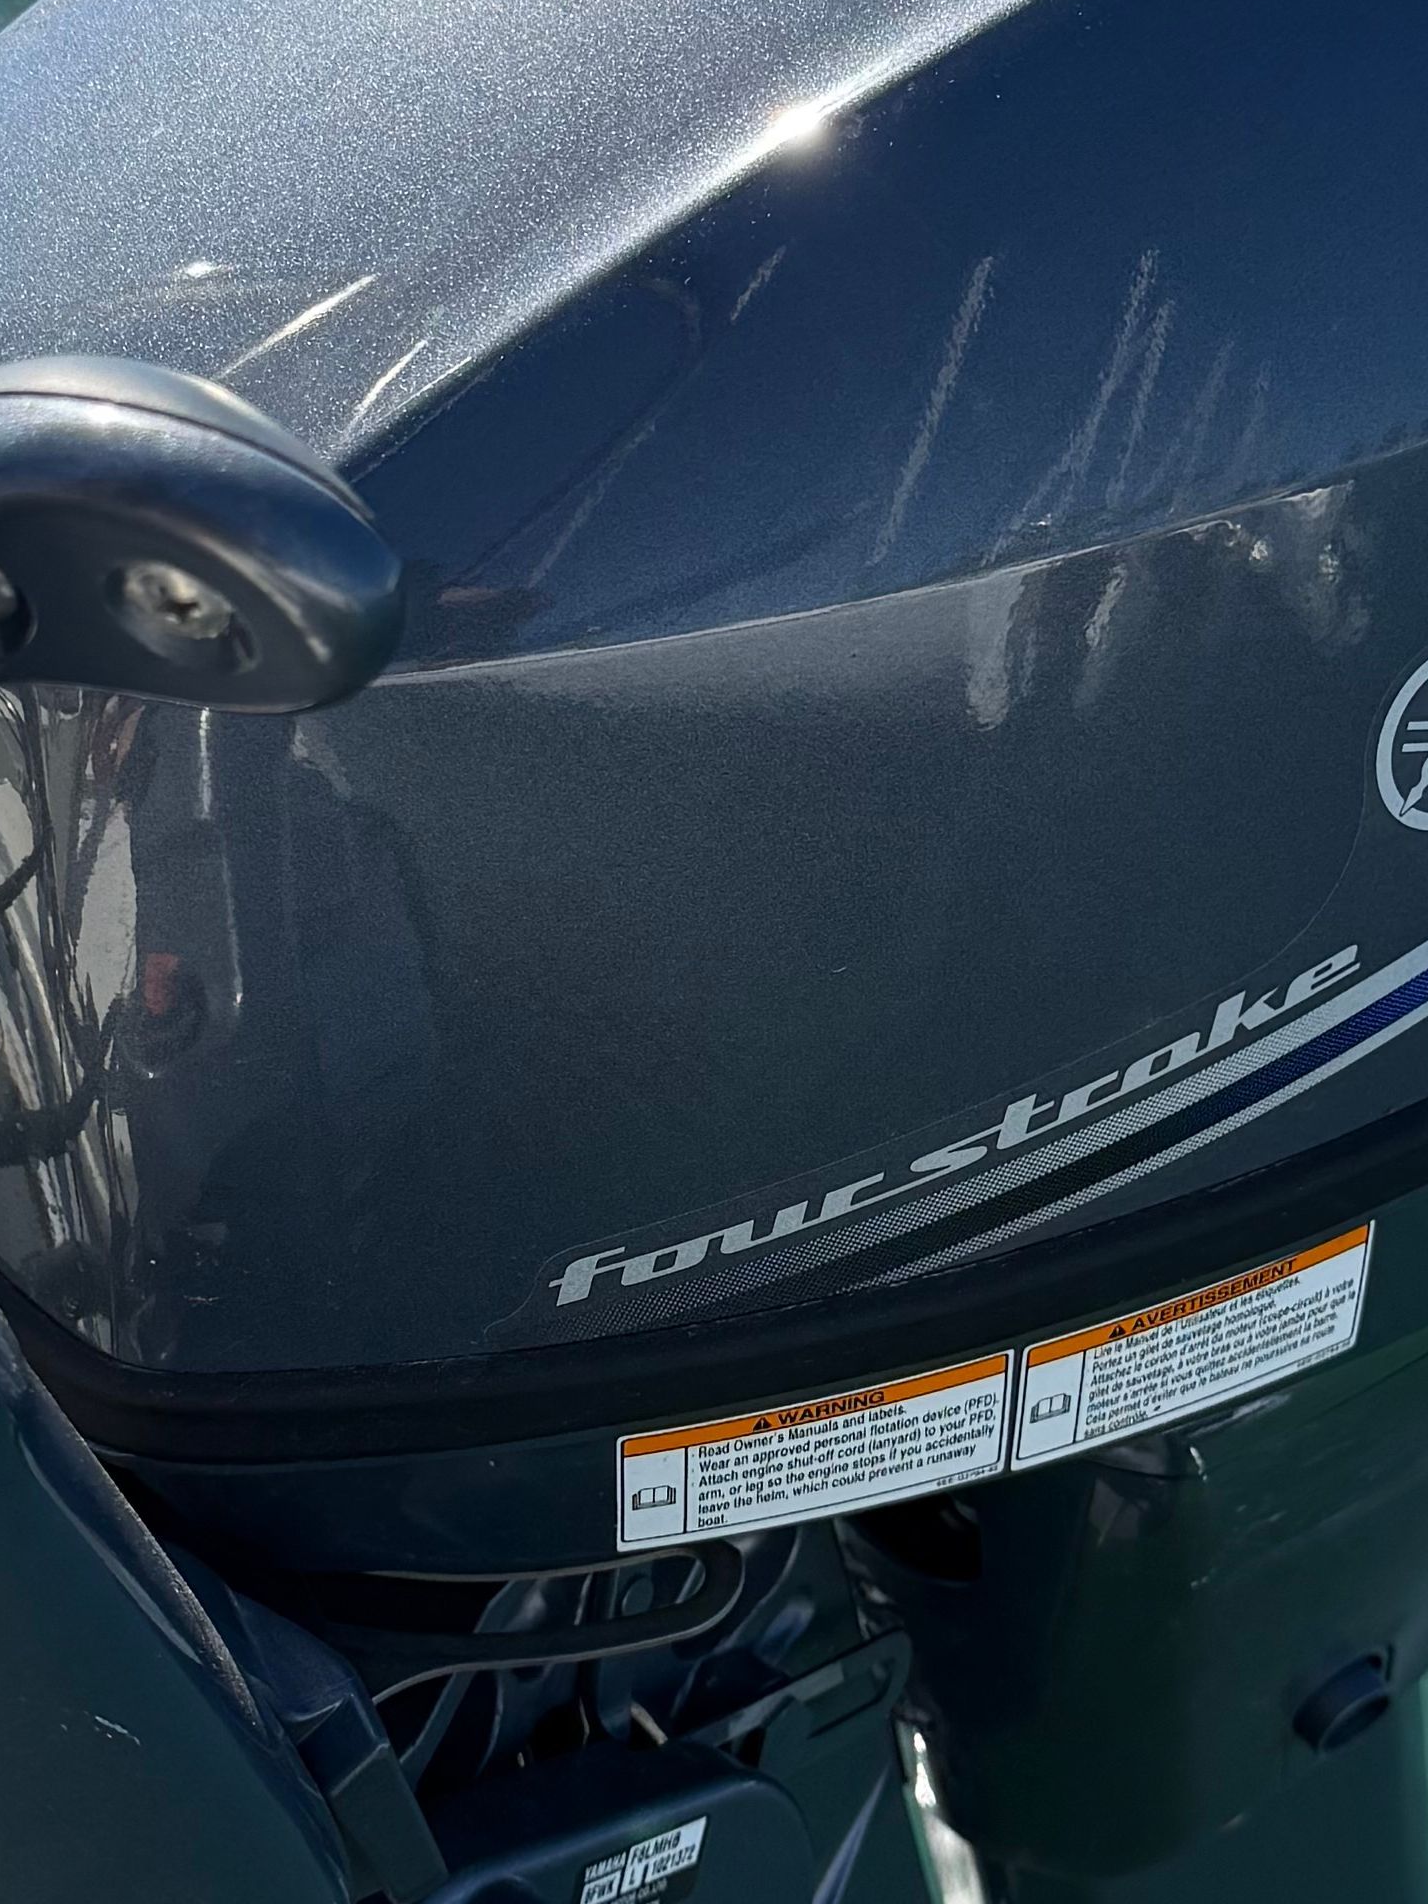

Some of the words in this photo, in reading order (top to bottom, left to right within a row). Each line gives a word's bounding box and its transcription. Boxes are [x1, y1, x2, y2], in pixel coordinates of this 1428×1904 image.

[1131, 1258, 1296, 1331] AVERTISSEMENT
[698, 1439, 729, 1459] Read
[788, 1418, 838, 1440] Manuals
[842, 1412, 864, 1428] and
[699, 1455, 730, 1473] Wear
[734, 1454, 748, 1466] an
[752, 1440, 809, 1466] approved
[814, 1426, 866, 1452] personal
[870, 1414, 918, 1436] flotation
[923, 1402, 960, 1423] device
[777, 1390, 884, 1425] WARNING
[698, 1498, 730, 1515] leave
[733, 1494, 752, 1508] the
[792, 1478, 828, 1496] which
[831, 1470, 865, 1488] could
[868, 1458, 913, 1481] prevent
[916, 1457, 922, 1467] a
[927, 1443, 975, 1466] runaway
[699, 1469, 738, 1488] Attach
[742, 1460, 782, 1481] engine
[838, 1441, 864, 1458] cord
[925, 1424, 935, 1437] to
[939, 1418, 965, 1435] your
[729, 1484, 742, 1495] or
[746, 1478, 763, 1495] leg
[768, 1476, 781, 1487] so
[786, 1469, 804, 1484] the
[808, 1461, 848, 1481] engine
[852, 1451, 885, 1471] stops
[889, 1447, 896, 1460] if
[900, 1443, 921, 1460] you
[925, 1423, 994, 1452] accidentally
[584, 1851, 627, 1883] YAMAHA
